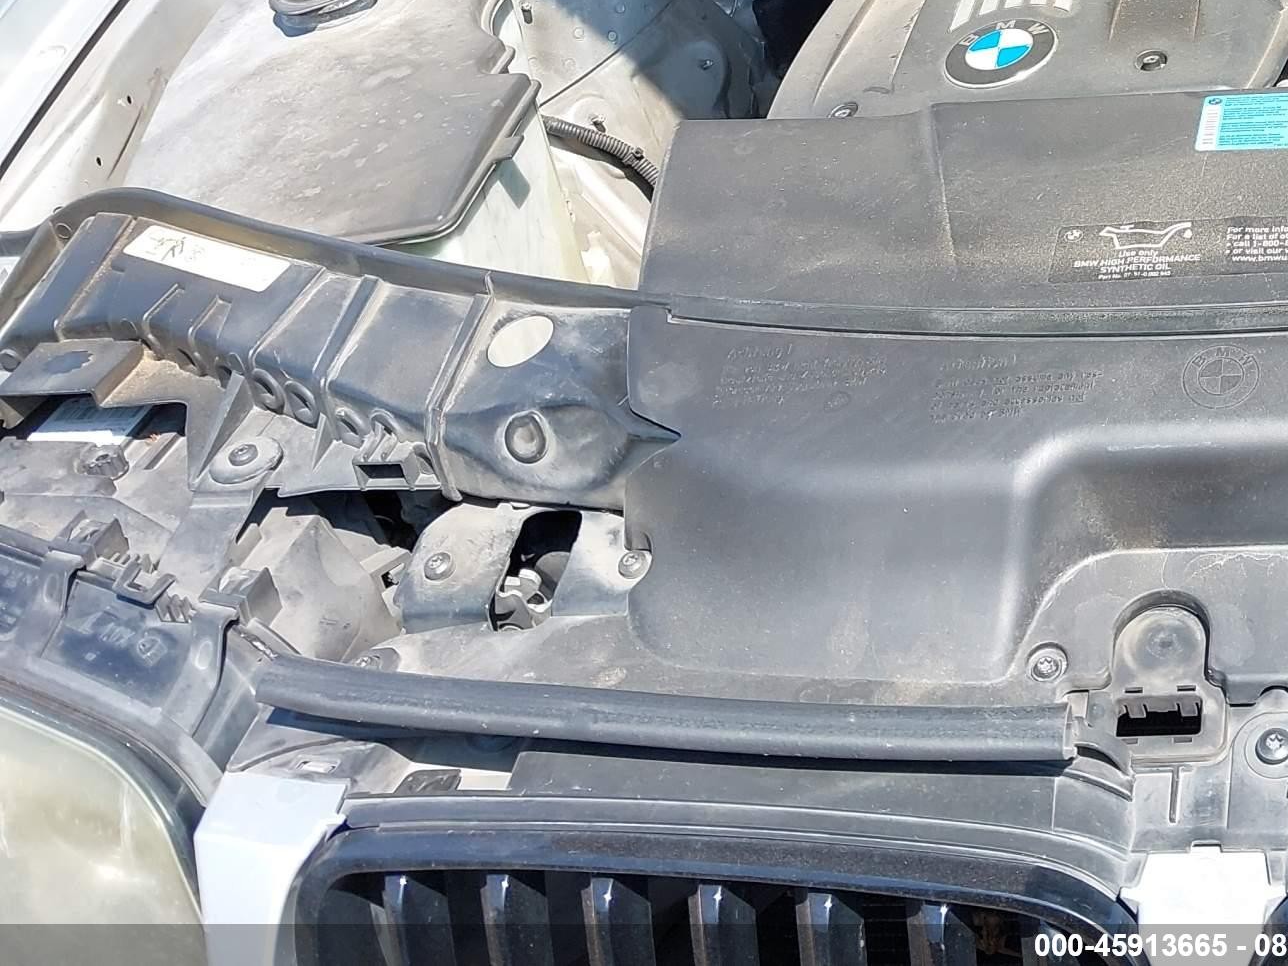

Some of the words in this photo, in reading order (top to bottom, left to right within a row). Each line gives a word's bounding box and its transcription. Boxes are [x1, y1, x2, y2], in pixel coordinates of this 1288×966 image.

[959, 19, 1050, 46] BMW
[1119, 250, 1136, 258] Use
[1139, 249, 1158, 257] only
[1074, 260, 1099, 268] BMW
[1100, 258, 1124, 267] HIGH
[1127, 254, 1201, 265] PERFORMANCE
[1100, 263, 1154, 274] SYNTHETIC
[1155, 262, 1172, 270] OIL
